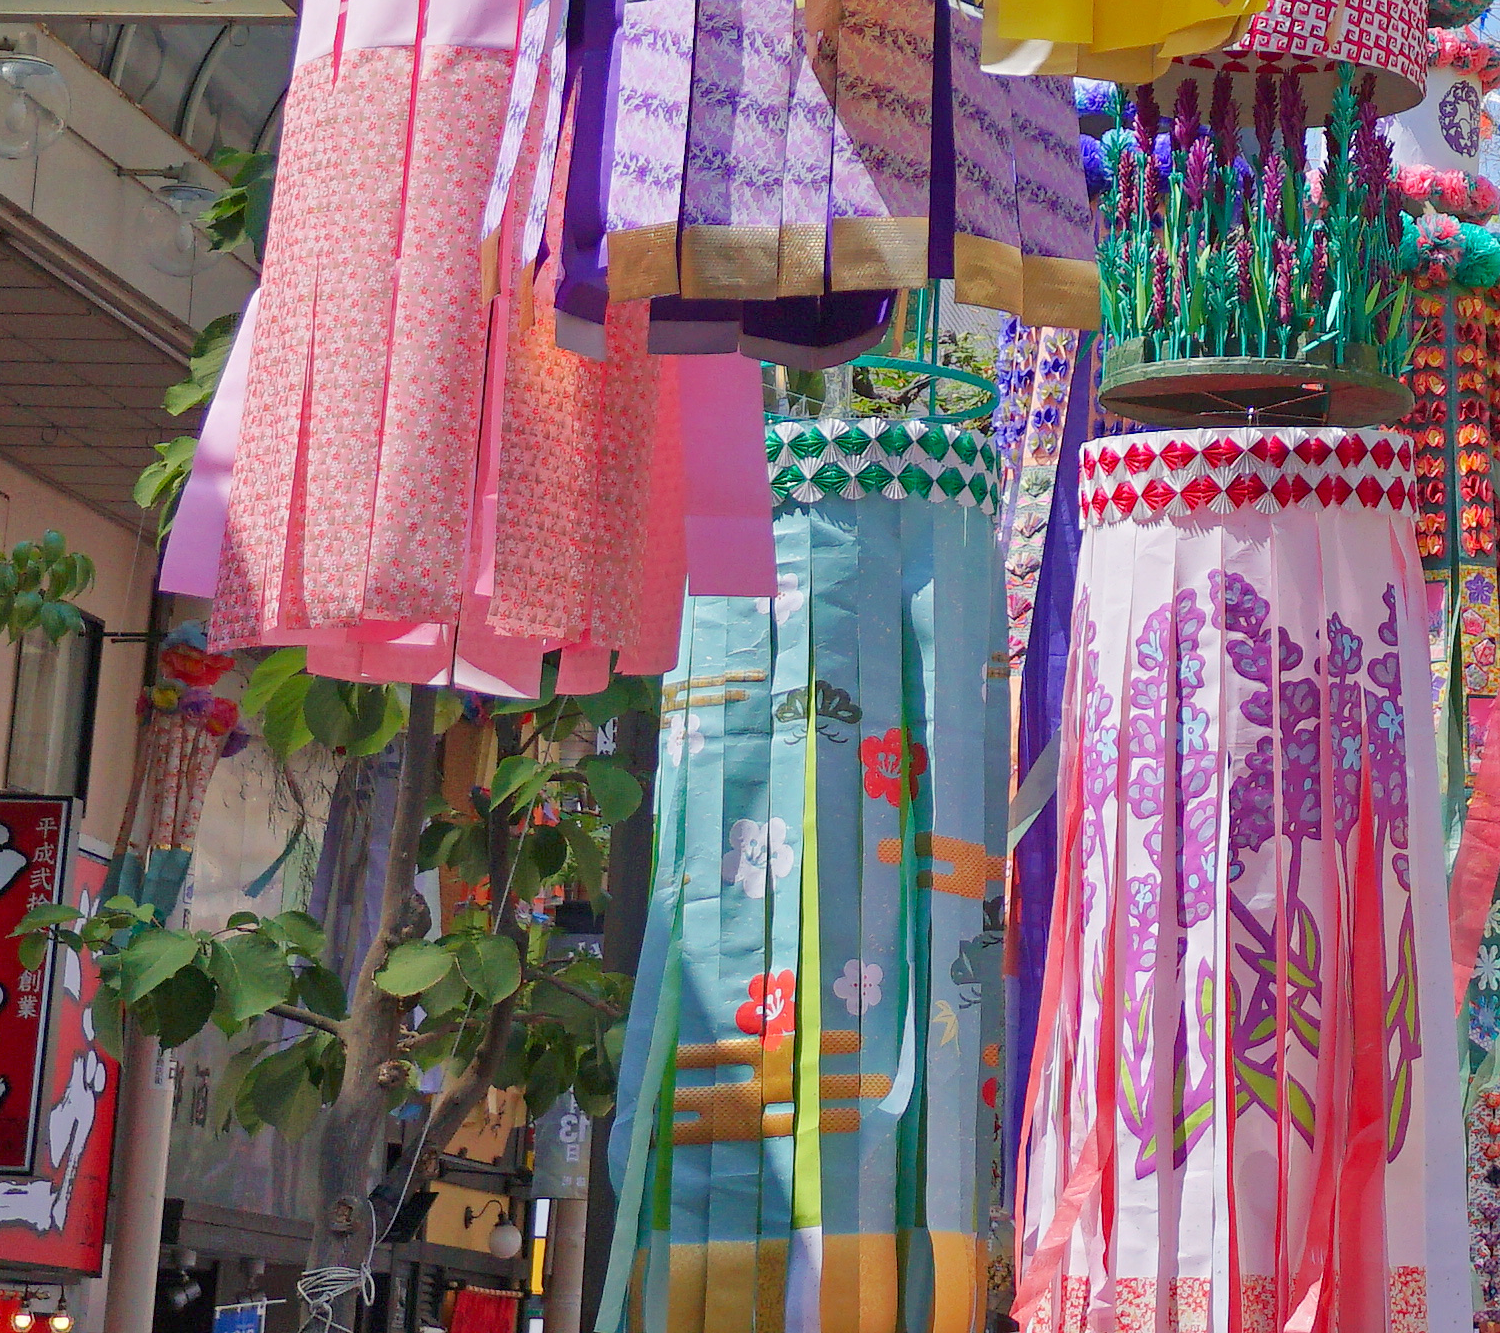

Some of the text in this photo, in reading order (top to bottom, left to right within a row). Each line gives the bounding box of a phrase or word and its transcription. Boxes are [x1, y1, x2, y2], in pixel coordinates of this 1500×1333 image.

[16, 817, 58, 1020] 平成弐拾創業
